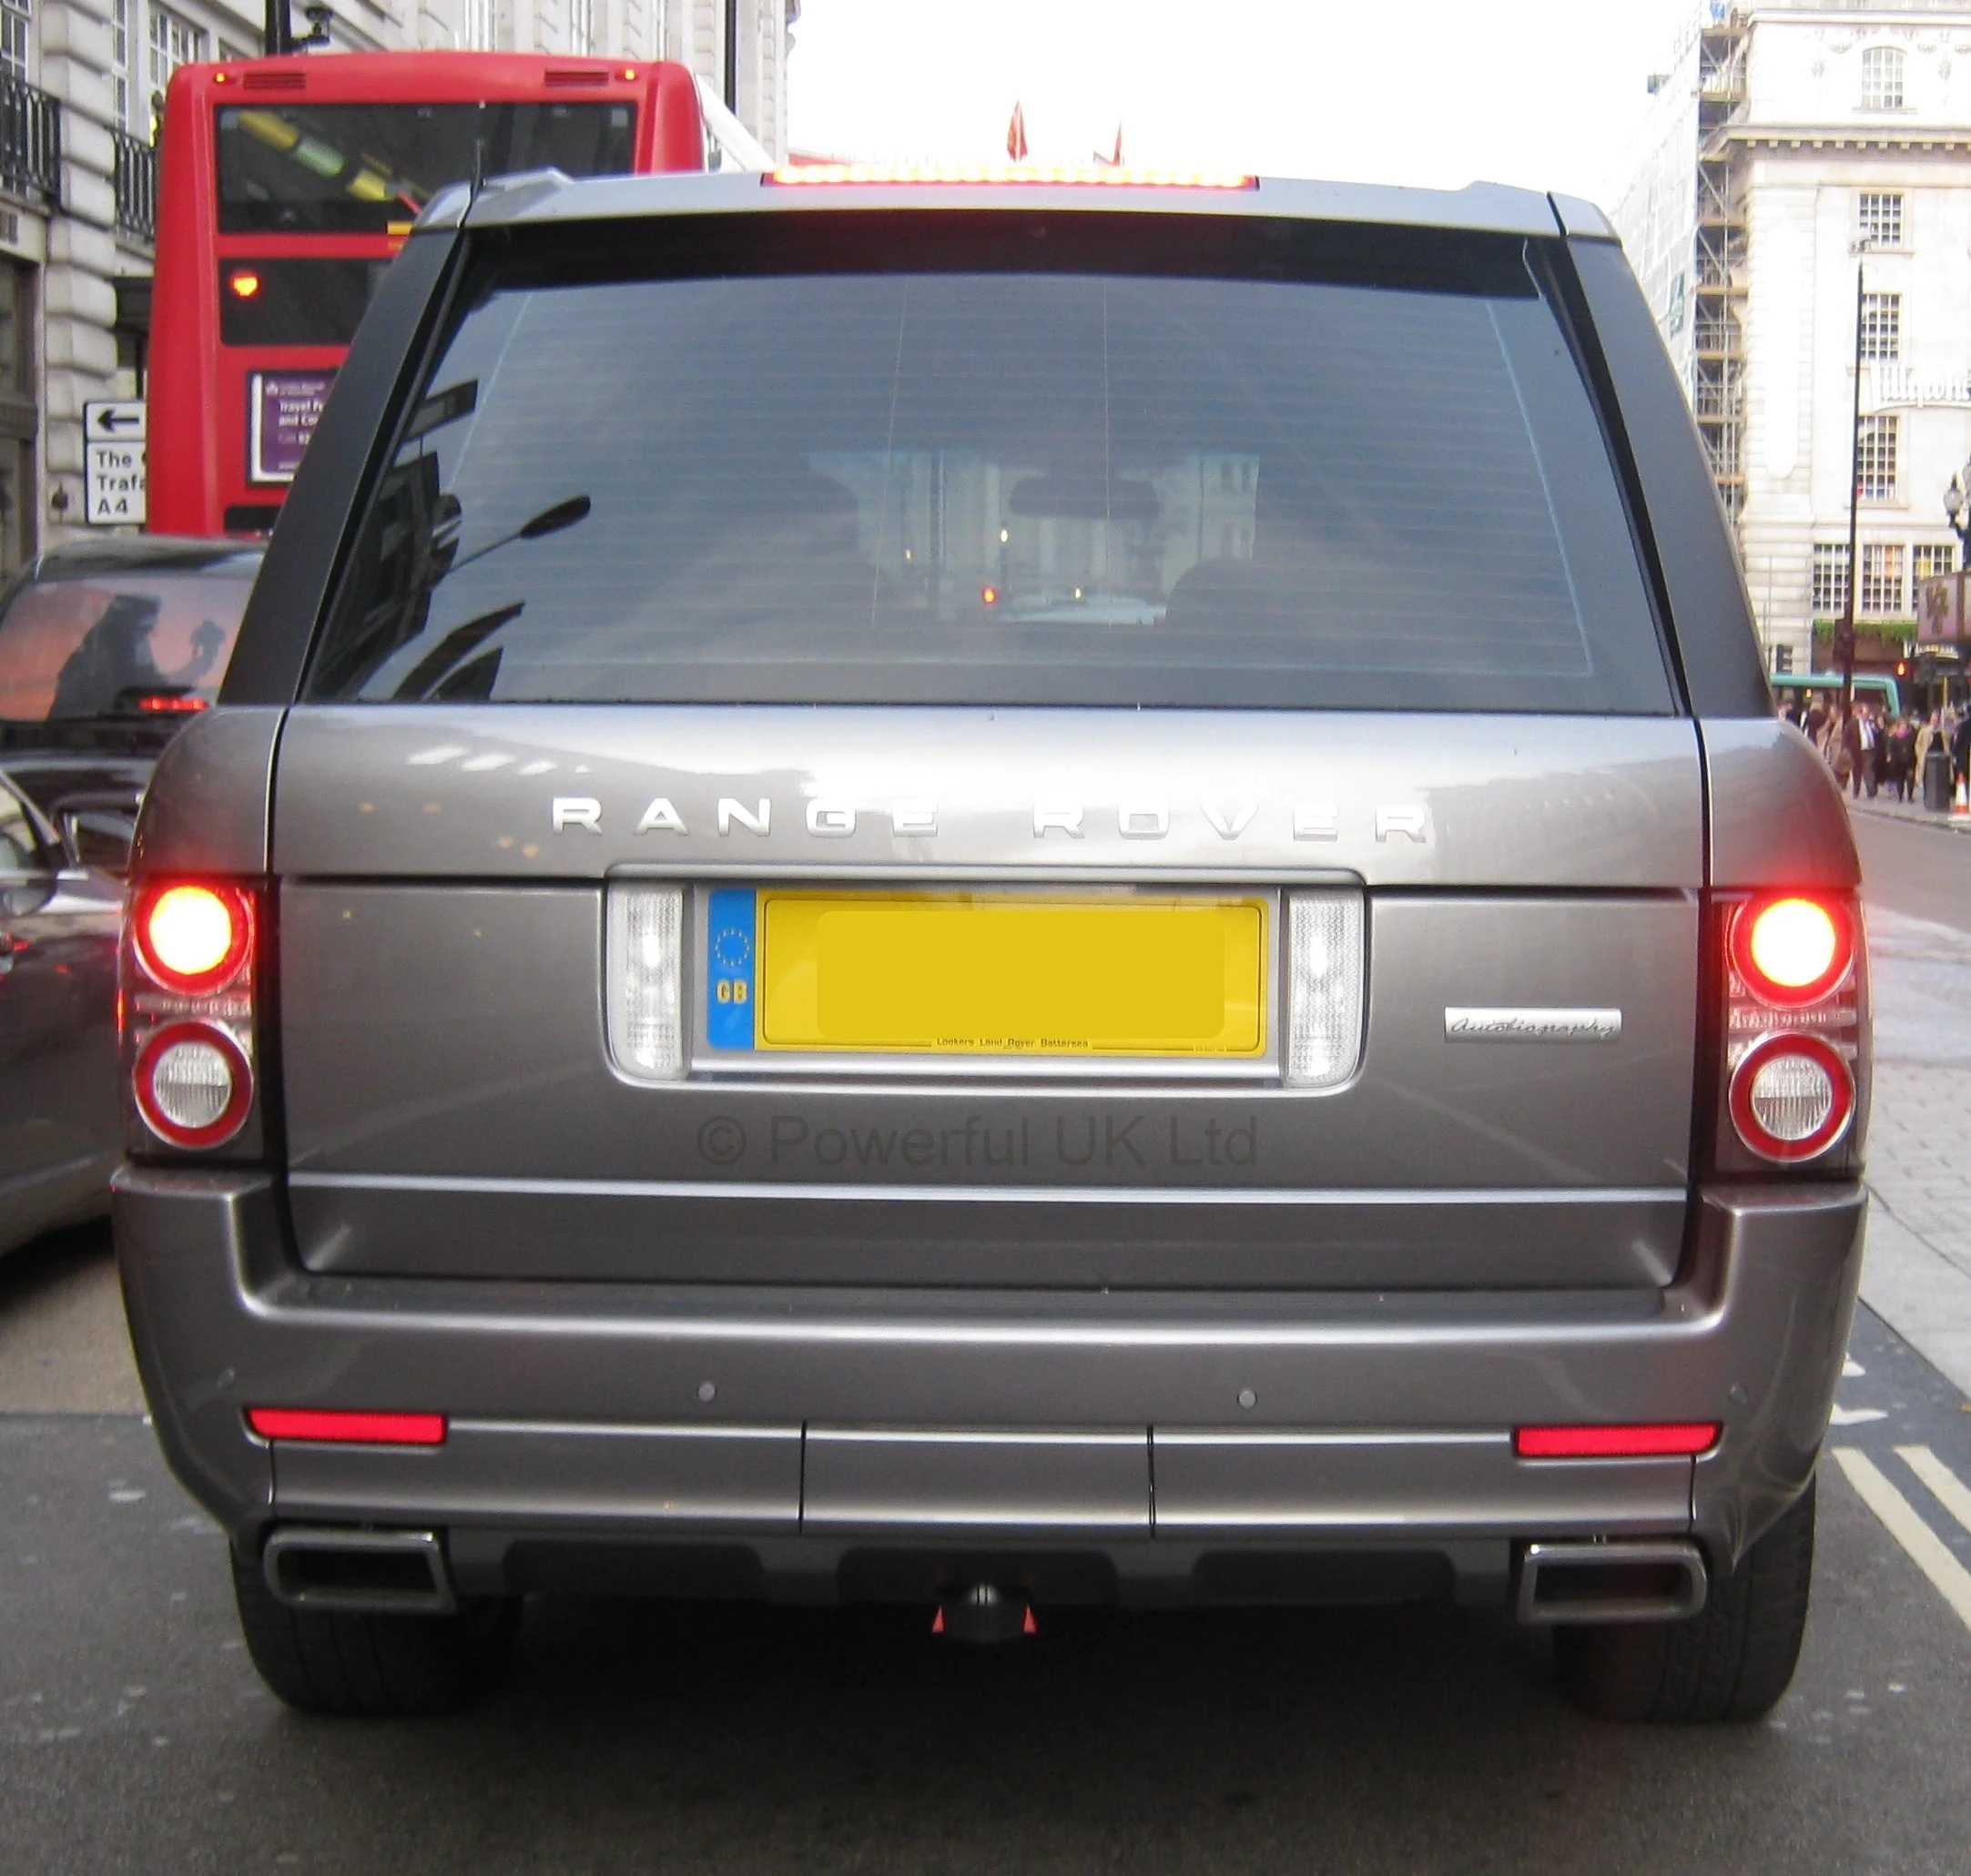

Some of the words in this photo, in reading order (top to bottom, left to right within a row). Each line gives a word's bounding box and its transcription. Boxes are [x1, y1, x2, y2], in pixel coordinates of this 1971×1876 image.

[279, 415, 299, 426] and
[97, 451, 132, 468] The
[97, 498, 127, 514] A4
[552, 796, 940, 838] RANGE
[1031, 800, 1427, 843] ROVER
[716, 979, 747, 1005] GB
[1450, 1018, 1617, 1039] Autobiography
[936, 1038, 975, 1047] Lookers
[980, 1038, 1002, 1047] Land
[1007, 1038, 1035, 1048] Rover
[1041, 1039, 1089, 1048] Battersea
